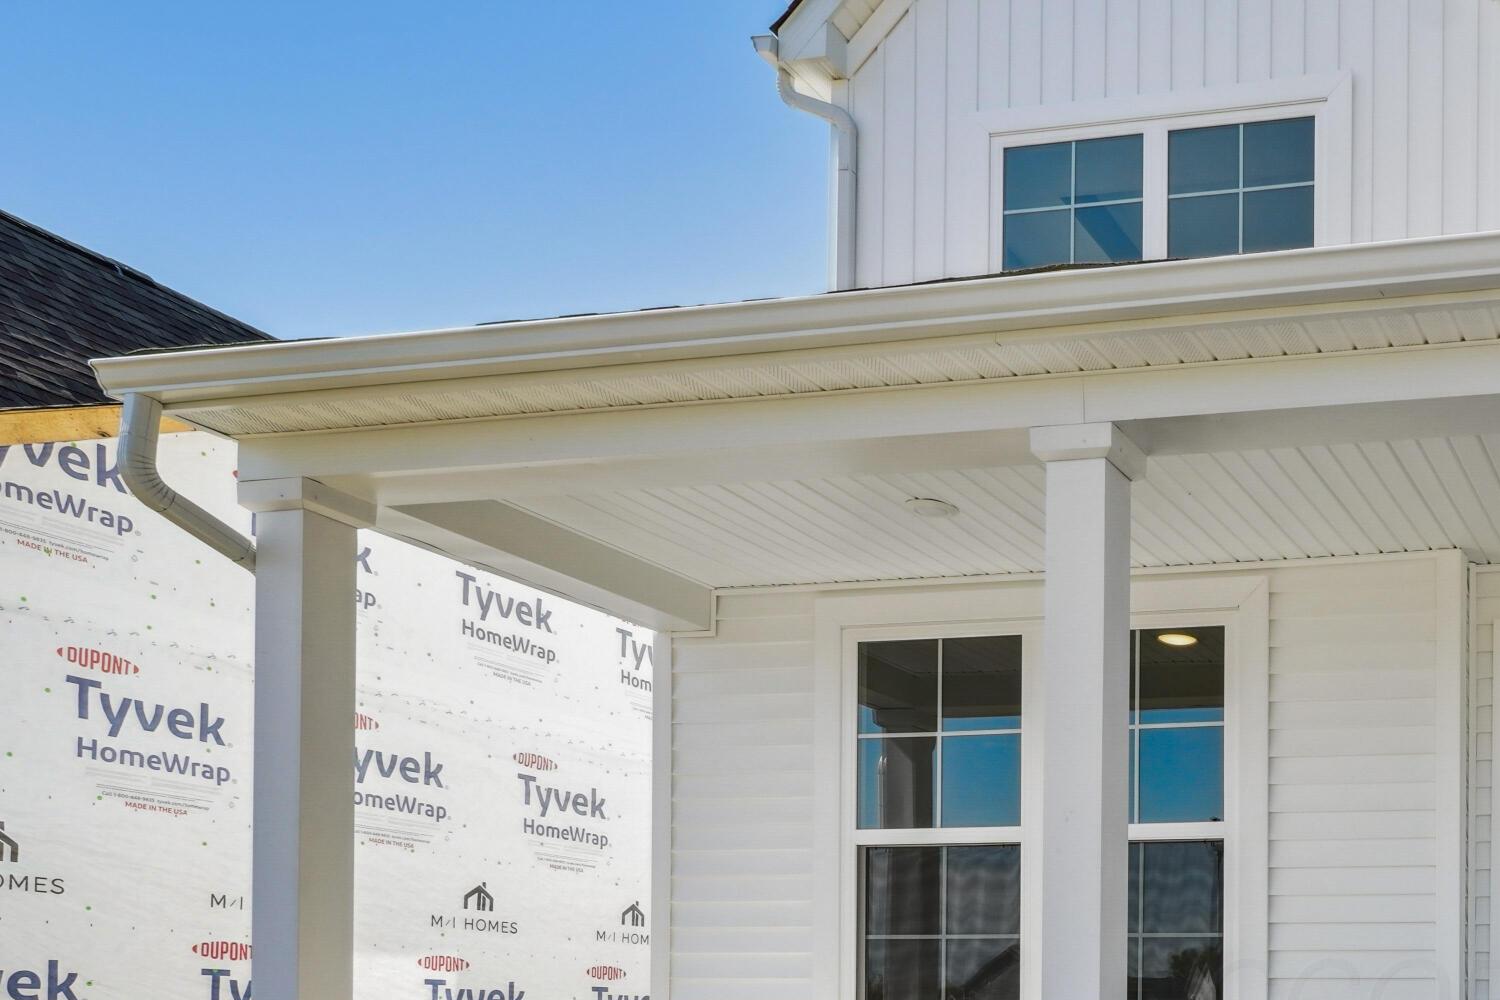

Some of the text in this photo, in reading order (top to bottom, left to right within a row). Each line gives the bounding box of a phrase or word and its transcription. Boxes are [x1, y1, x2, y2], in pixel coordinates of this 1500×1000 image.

[17, 539, 42, 551] MADE
[55, 549, 71, 559] THE
[456, 570, 554, 634] Tyvek
[461, 619, 556, 664] HomeWrap
[67, 646, 132, 675] DUPONT
[65, 674, 226, 747] Tyvek
[77, 736, 231, 786] HomeWrap
[518, 752, 553, 771] DUPONT
[124, 800, 147, 810] MADE
[159, 805, 172, 814] THE
[173, 808, 188, 816] USA
[517, 772, 606, 820] Tyvek
[523, 818, 609, 849] HomeWrap
[464, 917, 519, 935] HOMES
[622, 932, 649, 945] HOM
[424, 955, 464, 972] DUPONT
[591, 965, 623, 980] DUPONT
